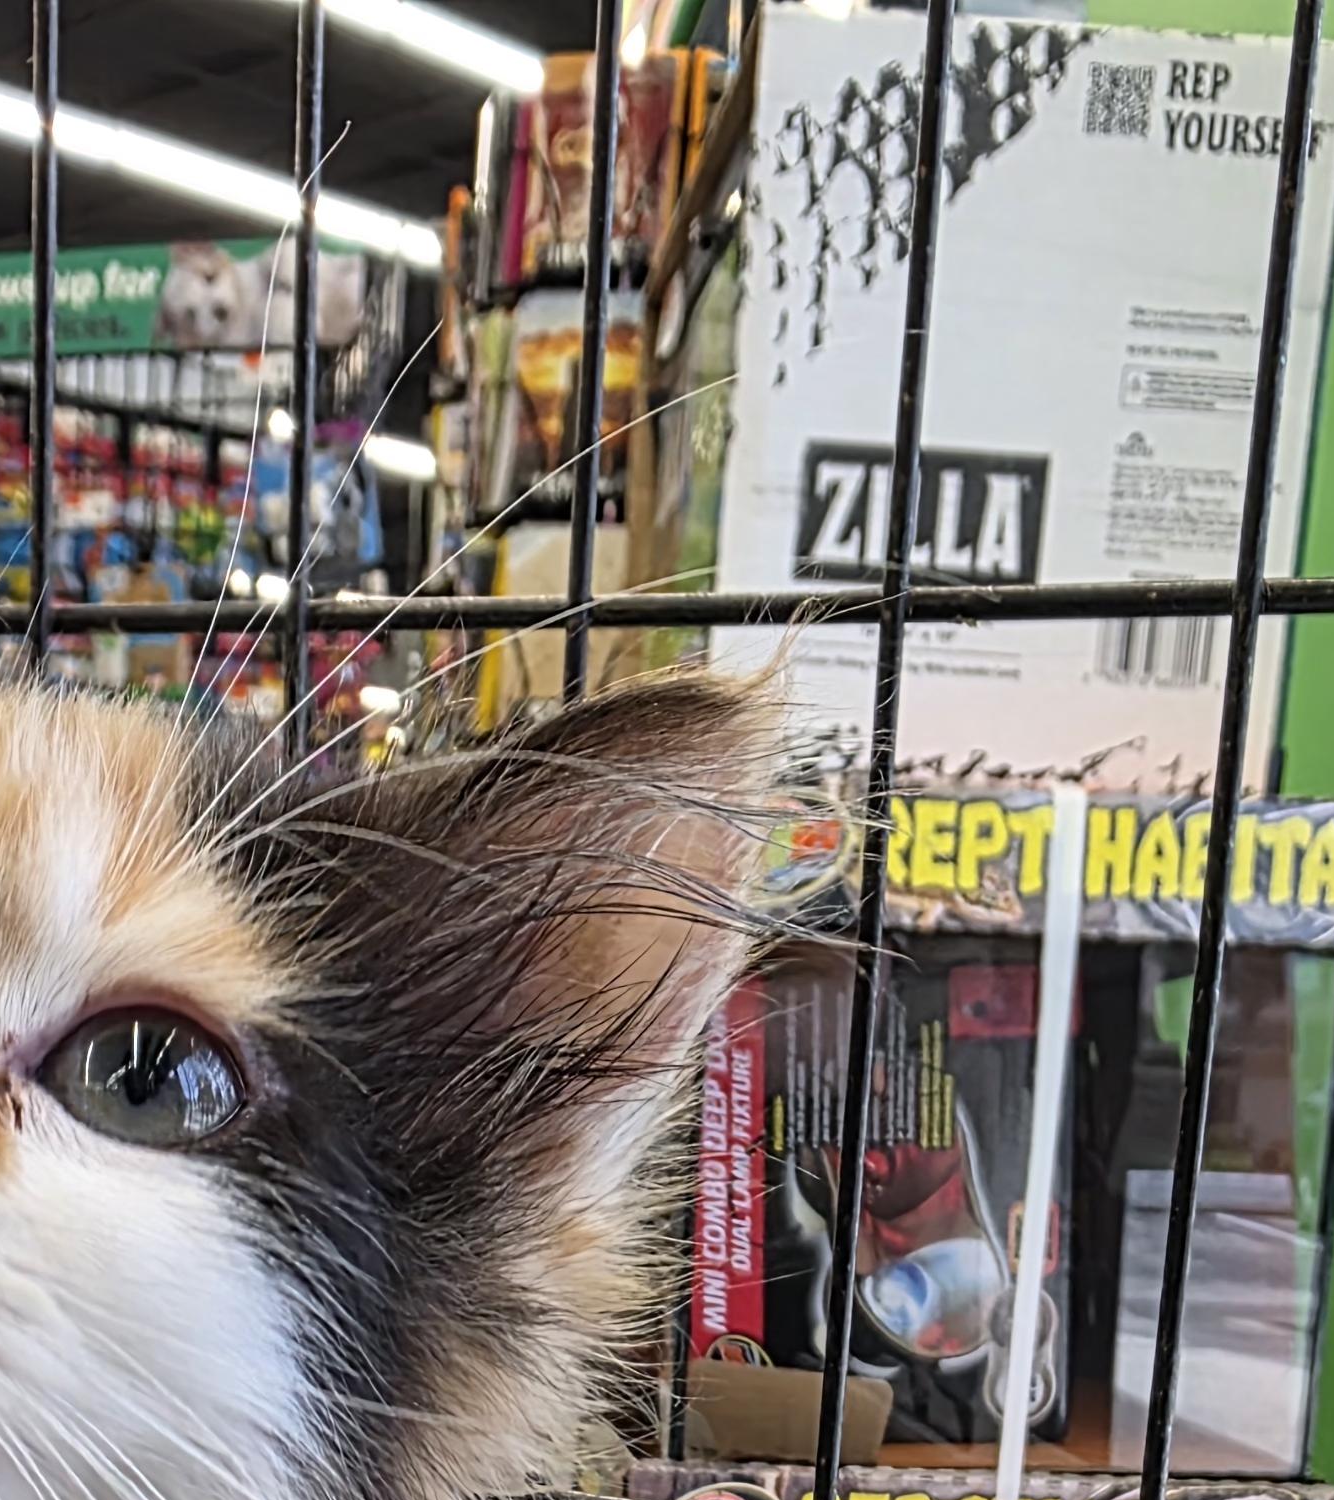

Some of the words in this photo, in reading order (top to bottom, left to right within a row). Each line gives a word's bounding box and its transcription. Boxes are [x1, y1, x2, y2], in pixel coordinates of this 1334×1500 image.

[1166, 59, 1232, 101] REP
[102, 259, 163, 300] for
[730, 1049, 754, 1142] FIXTURE
[730, 1145, 753, 1205] LAMP
[730, 1217, 751, 1273] DUAL
[702, 1267, 730, 1332] MINI
